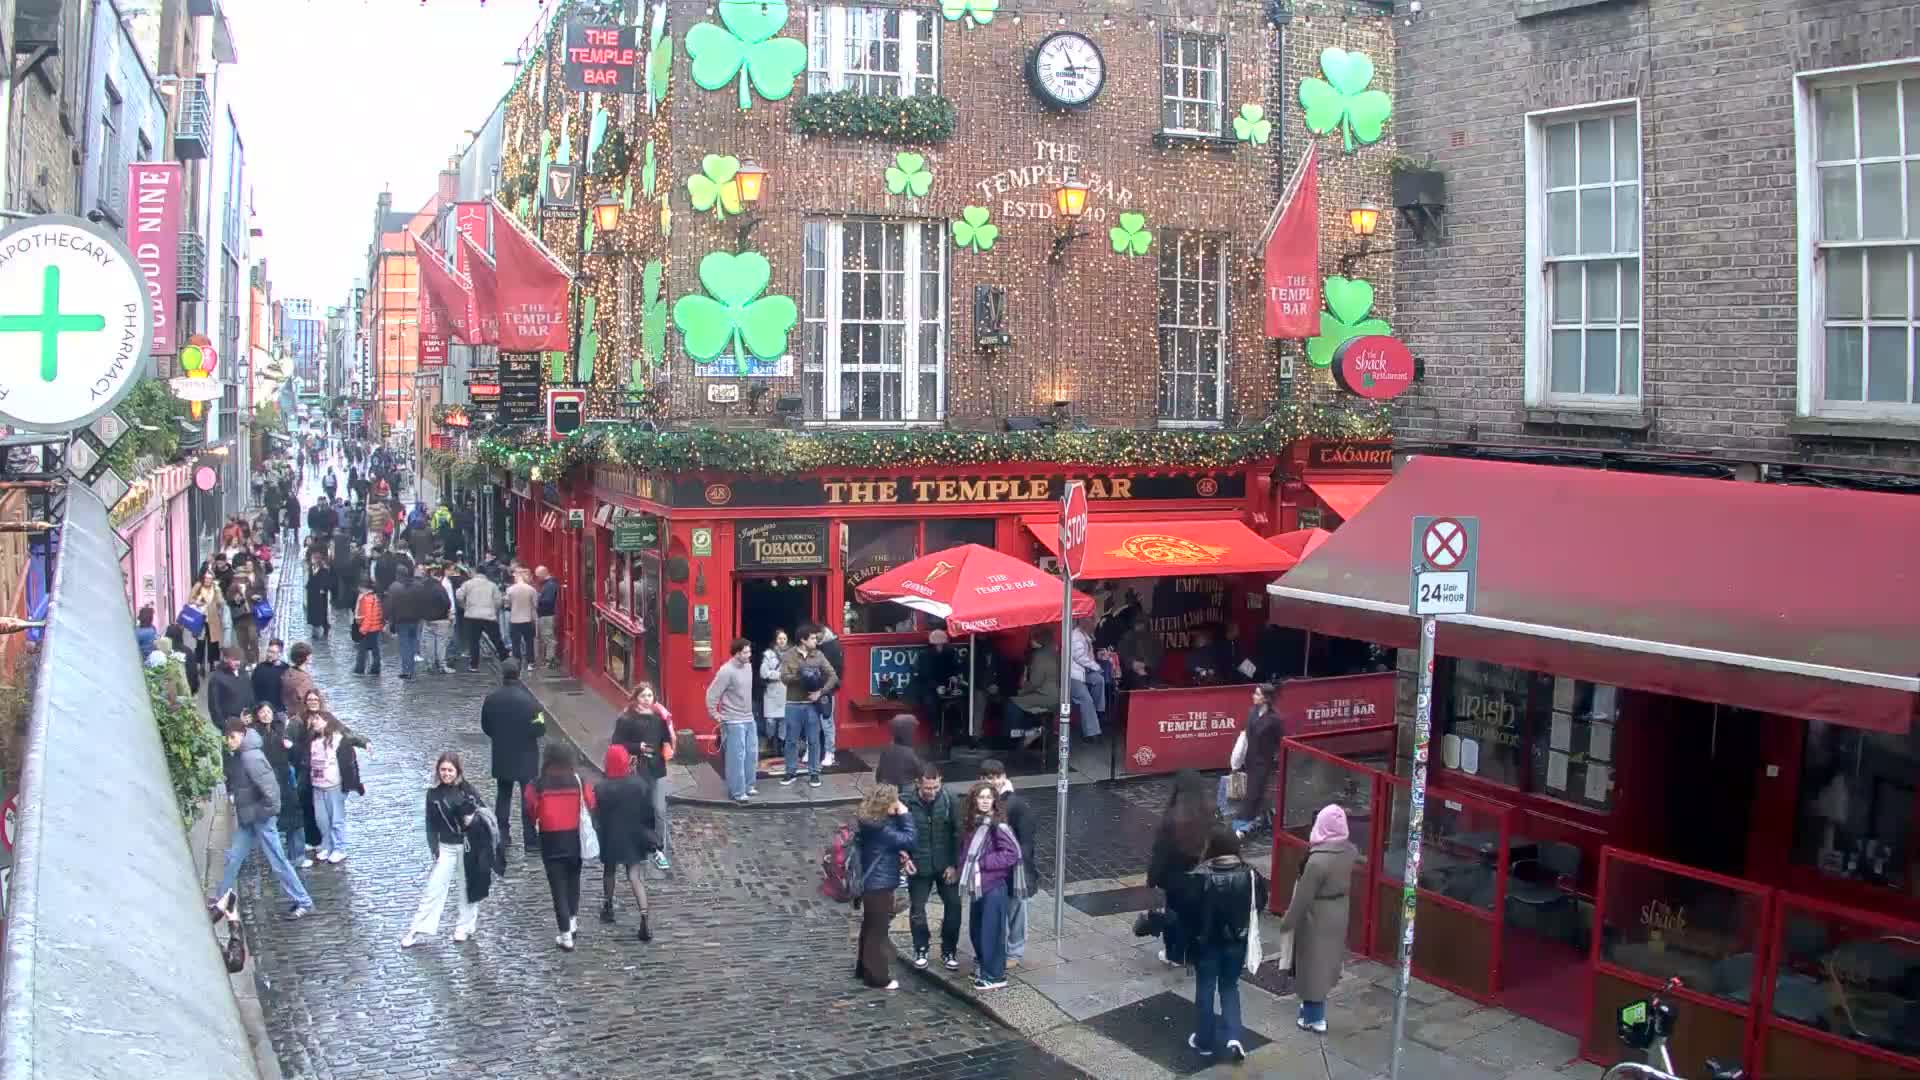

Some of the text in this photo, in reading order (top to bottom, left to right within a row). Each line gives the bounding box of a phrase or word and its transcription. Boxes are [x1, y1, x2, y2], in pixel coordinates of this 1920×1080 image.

[585, 30, 619, 46] THE
[568, 47, 634, 65] TEMPLE
[583, 69, 617, 85] BAR
[1033, 140, 1080, 162] THE
[976, 165, 1132, 209] TEMPLE BAR
[138, 171, 170, 232] NINE
[0, 232, 113, 267] APOTHECARY
[1287, 276, 1307, 285] THE
[520, 304, 545, 312] THE
[1283, 303, 1308, 315] BAR
[503, 312, 564, 324] TEMPLE
[518, 325, 550, 336] BAR
[90, 303, 137, 401] PHARMACY
[502, 353, 539, 361] TEMPLE
[511, 362, 531, 370] BAR
[1355, 350, 1387, 372] Shack
[824, 479, 1133, 503] THE TEMPLE AR
[1066, 513, 1086, 550] STOP
[750, 538, 816, 561] TOBACCO
[872, 553, 889, 561] THE
[848, 565, 892, 587] TEMPLE
[987, 574, 1008, 583] THE
[901, 580, 936, 597] GUINNESS
[974, 580, 1037, 596] TEMPLE BAR
[1420, 584, 1442, 603] 24
[1443, 594, 1465, 603] HOUR
[961, 617, 998, 630] GUINNESS
[1333, 699, 1351, 707] THE
[1187, 711, 1208, 720] THE
[1306, 703, 1376, 720] TEMPLE BAR
[1158, 717, 1236, 733] TEMPLE BAR
